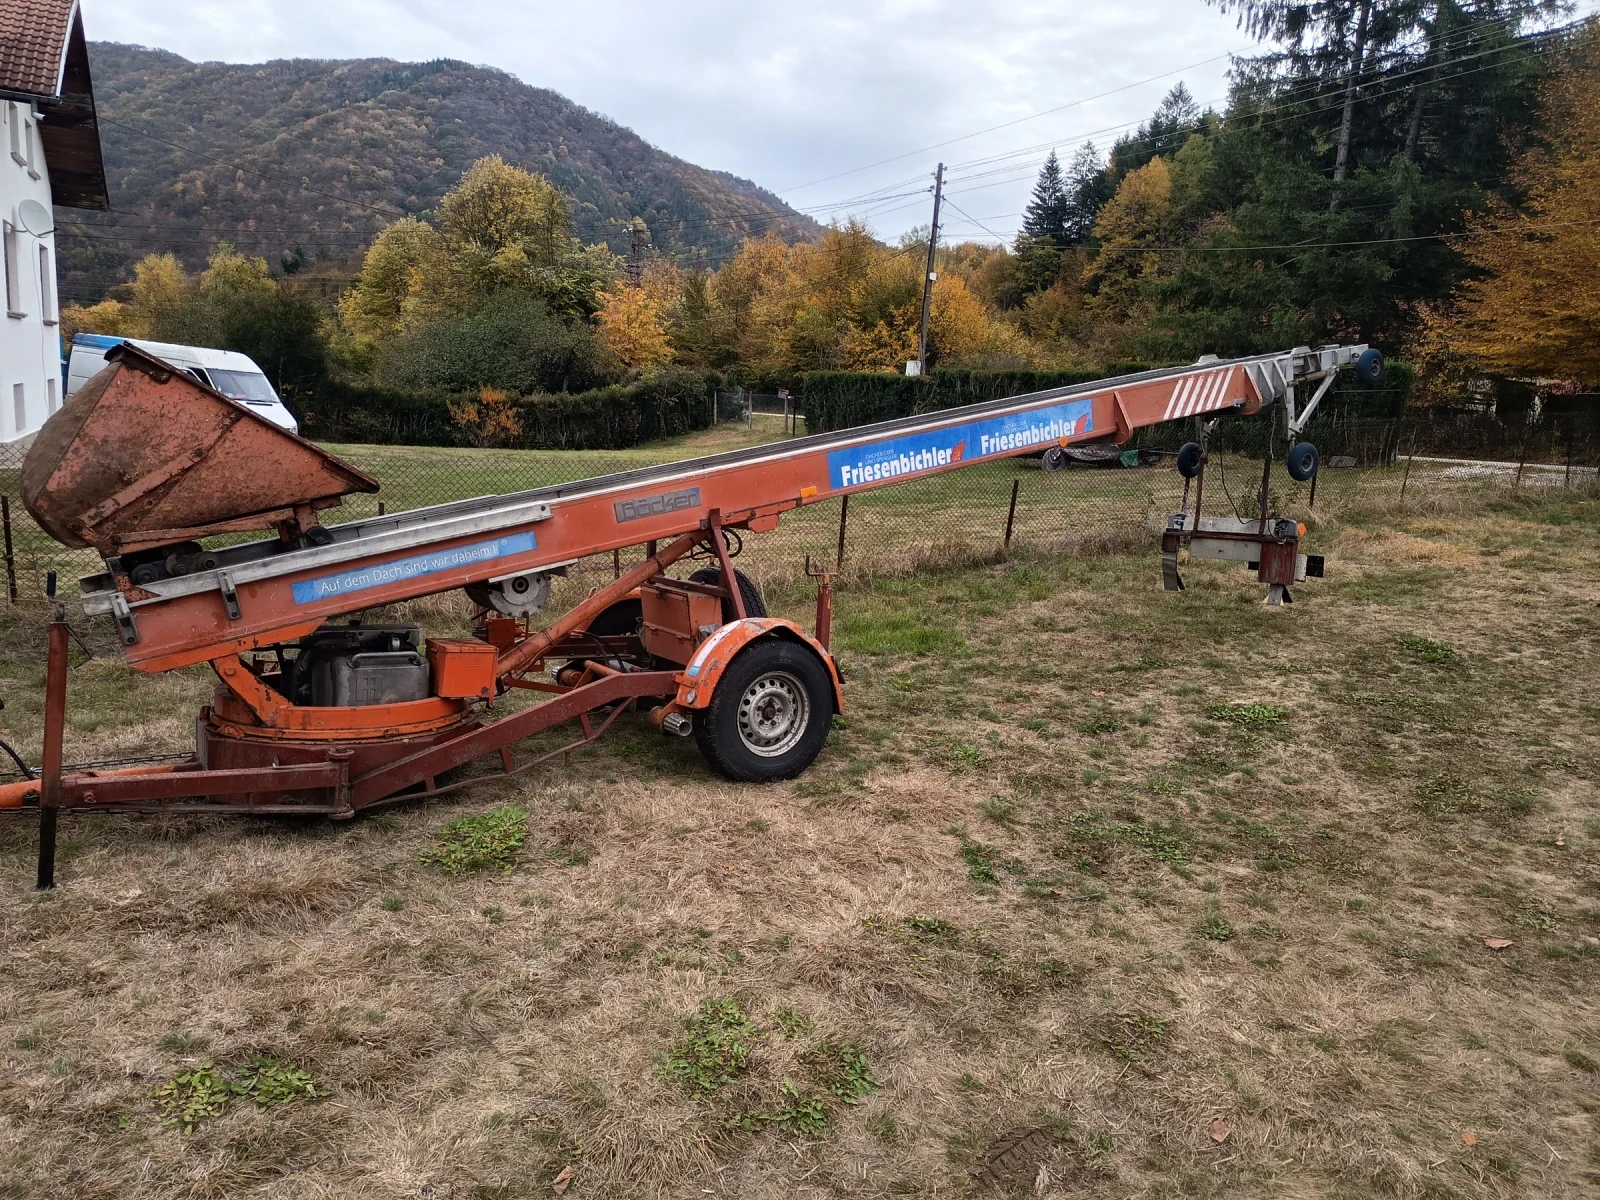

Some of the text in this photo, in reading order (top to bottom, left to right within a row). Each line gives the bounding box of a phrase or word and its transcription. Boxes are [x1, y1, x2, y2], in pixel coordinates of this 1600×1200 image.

[981, 419, 1076, 455] Friesenbichler
[841, 446, 952, 487] Friesenbichler
[622, 493, 697, 520] Böcker
[321, 578, 341, 594] Auf
[344, 575, 370, 588] dem
[372, 566, 403, 581] Dach
[405, 559, 429, 574] sind
[430, 554, 448, 568] wir
[451, 545, 490, 564] daheim
